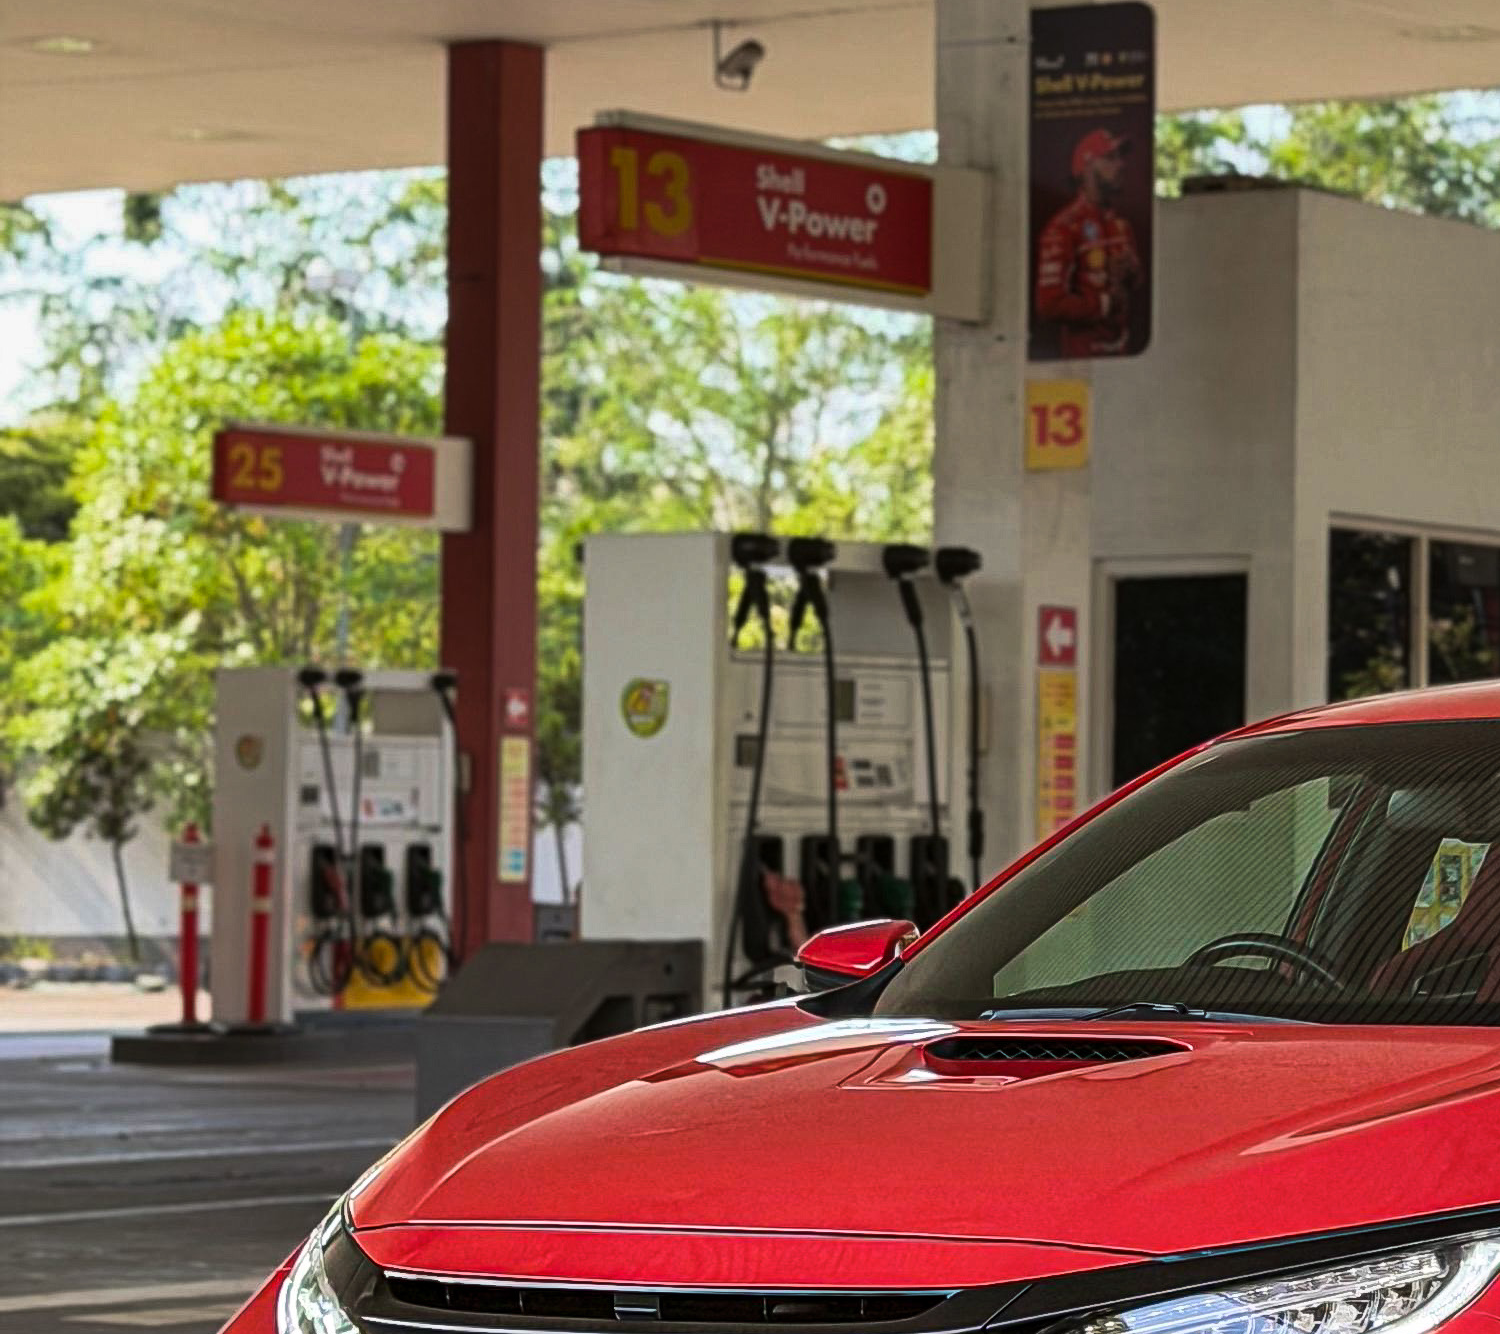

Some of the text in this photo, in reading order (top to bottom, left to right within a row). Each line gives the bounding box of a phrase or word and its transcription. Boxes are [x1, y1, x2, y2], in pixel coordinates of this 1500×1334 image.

[611, 146, 692, 236] 13
[756, 165, 806, 194] Shell
[756, 194, 878, 245] V-Power
[1031, 403, 1083, 447] 13
[229, 443, 284, 492] 25
